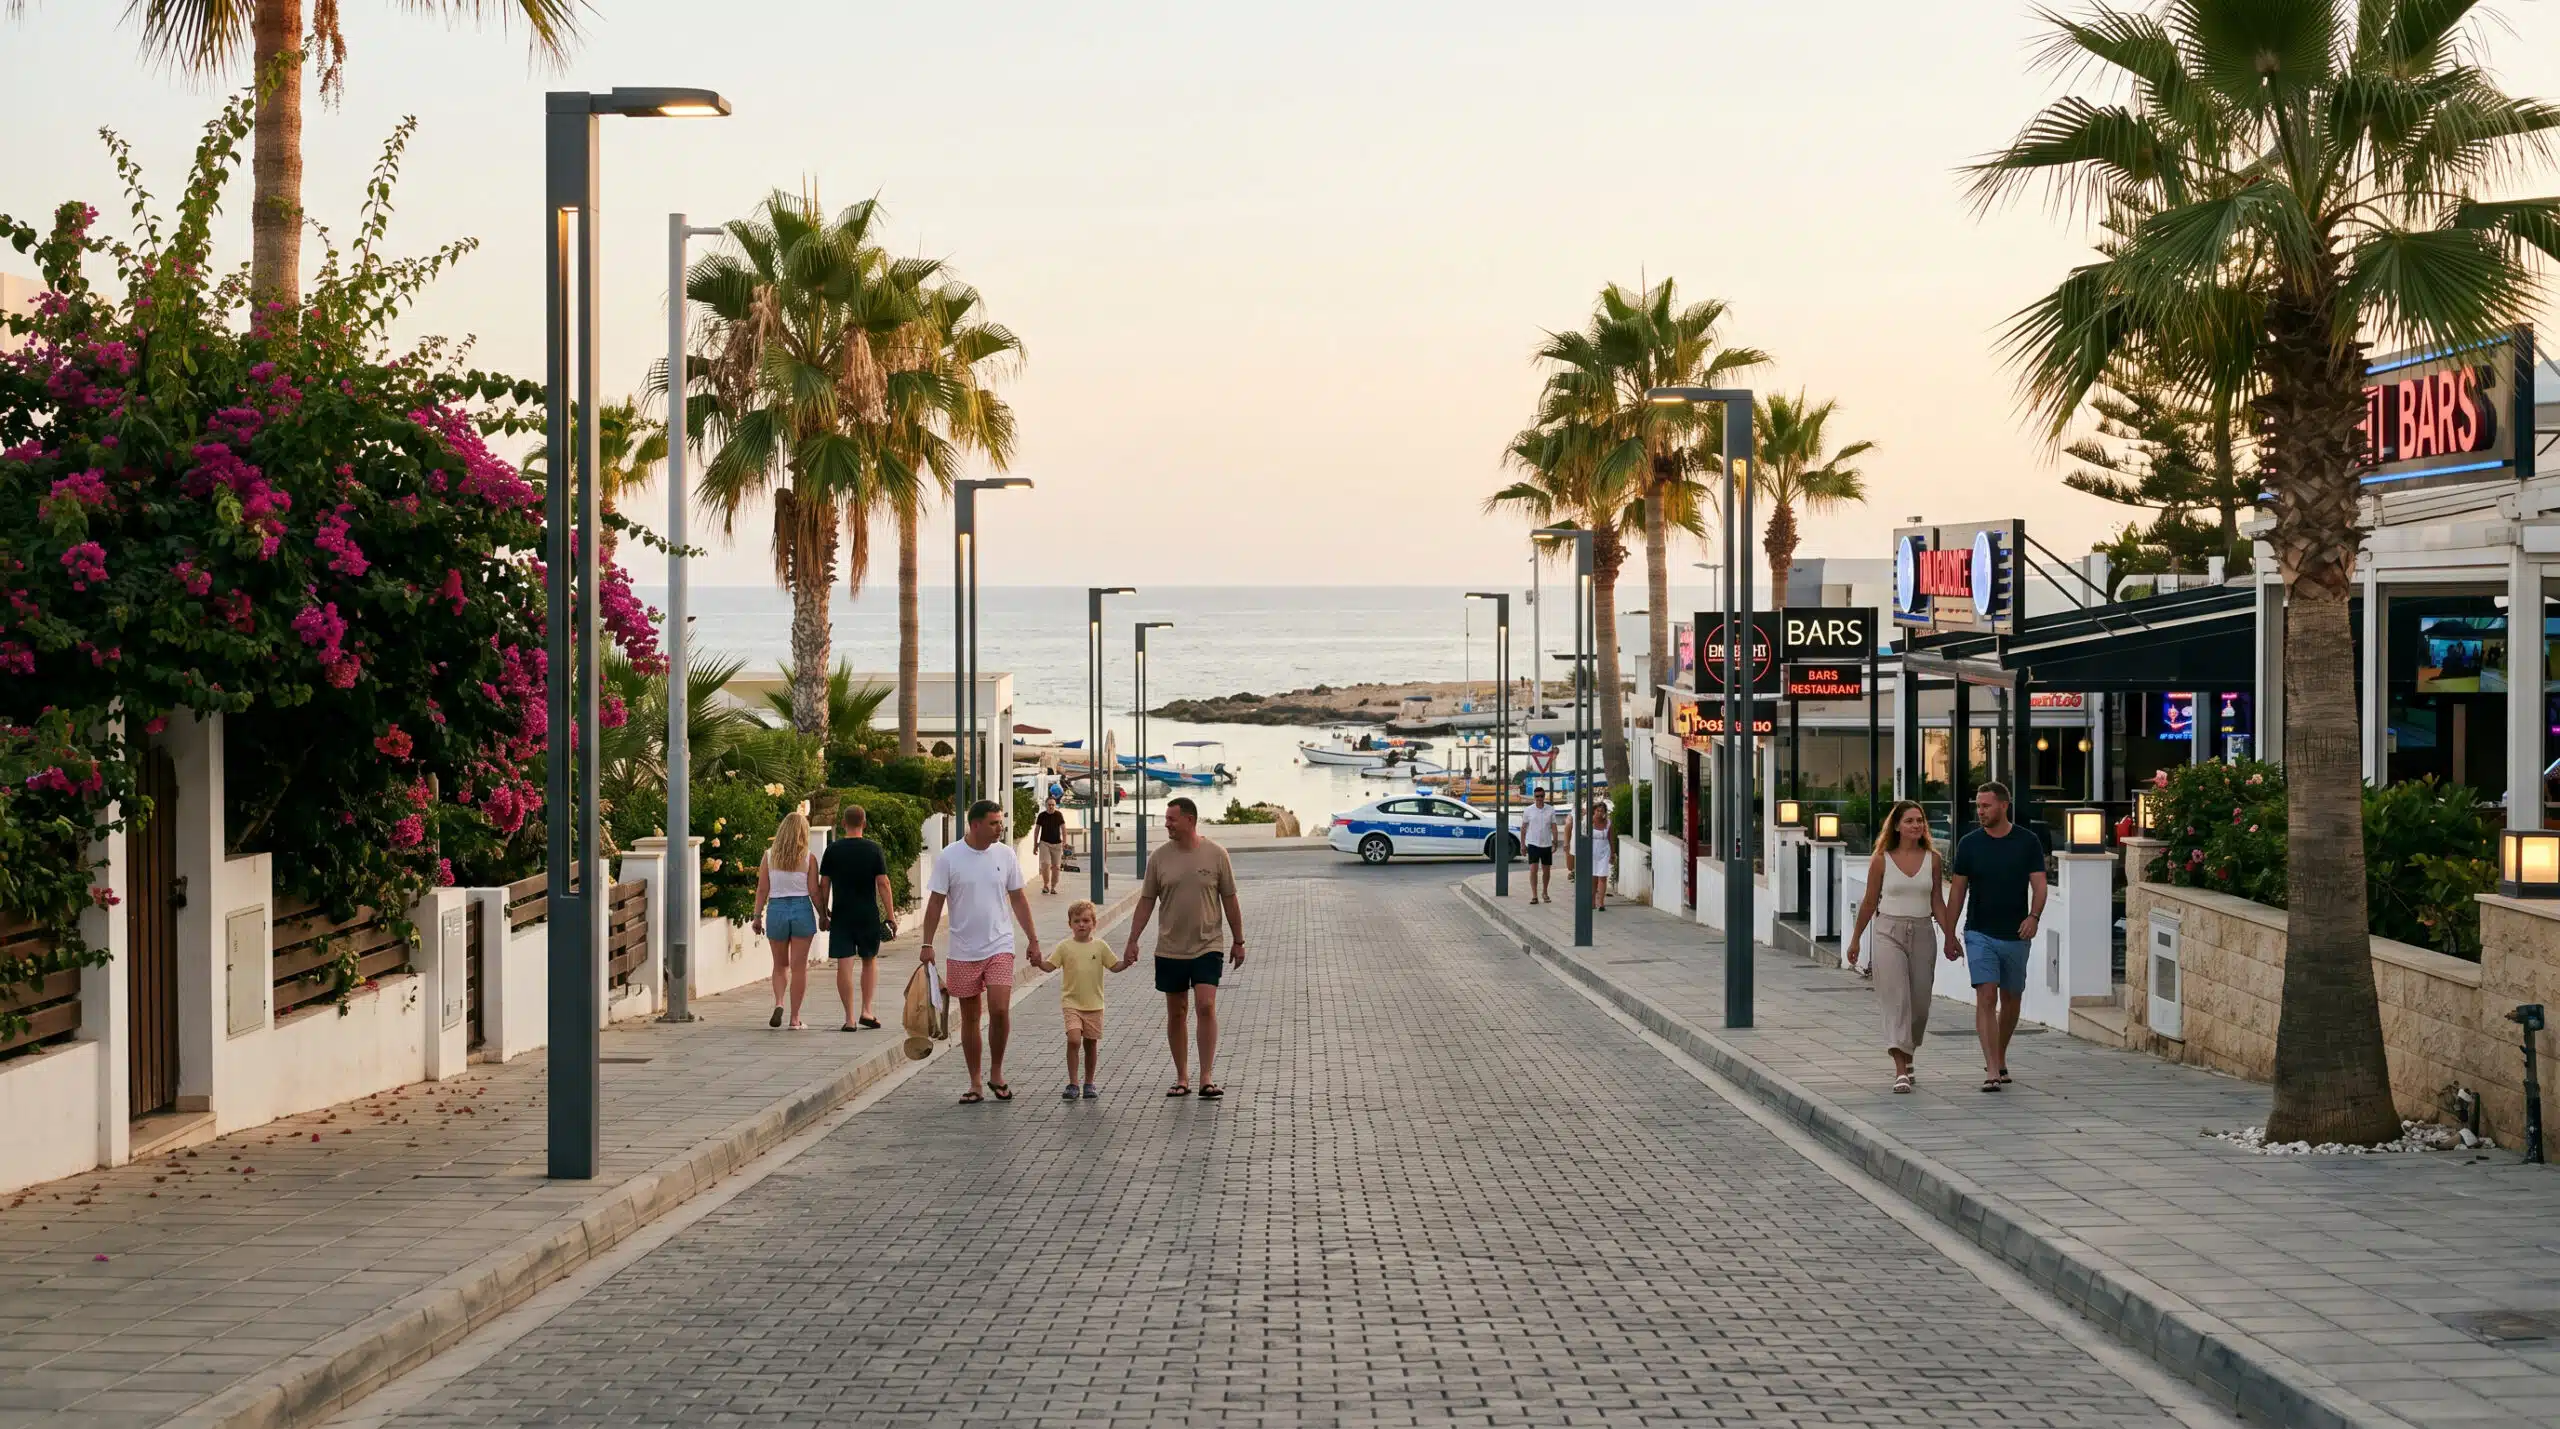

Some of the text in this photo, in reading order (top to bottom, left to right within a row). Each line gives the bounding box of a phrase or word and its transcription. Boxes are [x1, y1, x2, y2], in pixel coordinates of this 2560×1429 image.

[2399, 365, 2477, 460] BARS
[1787, 620, 1862, 645] BARS
[1808, 670, 1838, 680] BARS
[1791, 684, 1860, 694] RESTAURANT
[1400, 826, 1426, 834] POLICE
